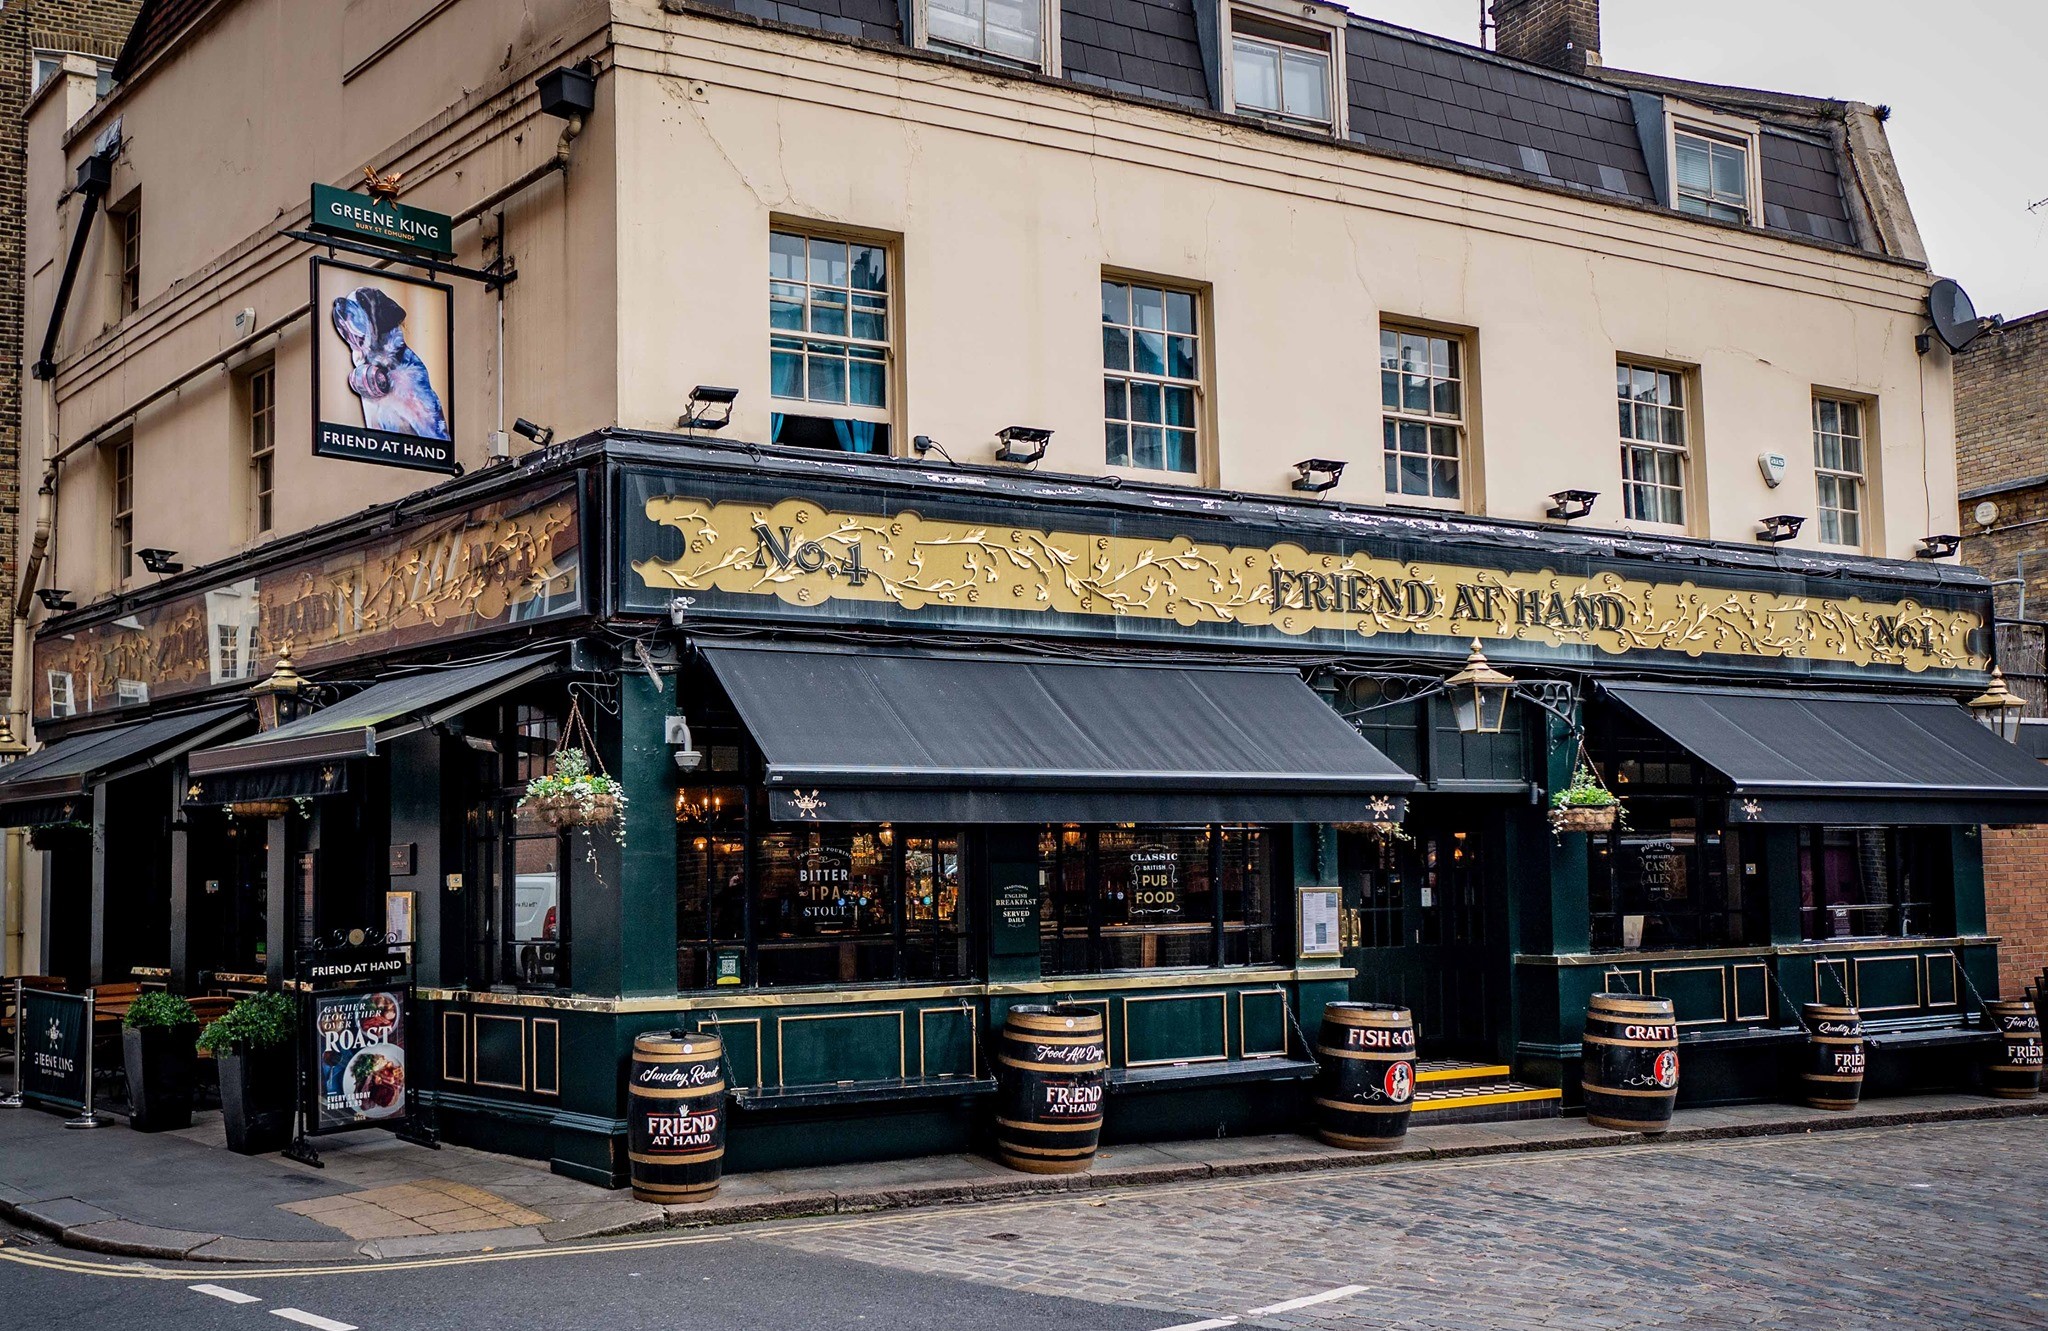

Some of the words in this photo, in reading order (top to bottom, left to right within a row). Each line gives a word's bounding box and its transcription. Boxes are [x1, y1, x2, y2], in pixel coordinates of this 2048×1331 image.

[331, 202, 394, 228] GREENE
[400, 218, 438, 239] KING
[355, 222, 373, 231] BURY
[384, 228, 415, 241] EDMUNDS
[323, 431, 378, 450] FRIEND
[381, 440, 400, 454] AT
[404, 443, 446, 460] HAND
[751, 523, 868, 587] No.4
[1269, 566, 1437, 617] FRIEND
[1450, 581, 1502, 622] AT
[1515, 588, 1627, 631] HAND
[1874, 614, 1934, 656] No.4
[826, 847, 853, 859] POURING
[1130, 852, 1178, 862] CLASSIC
[1645, 861, 1672, 872] CASK
[800, 869, 848, 882] BITTER
[1142, 874, 1168, 887] PUB
[1646, 873, 1671, 884] ALES
[812, 885, 841, 901] IPA
[1136, 891, 1175, 904] FOOD
[995, 898, 1038, 906] BREAKFAST
[804, 906, 847, 917] STOUT
[1002, 910, 1030, 918] SERVED
[312, 964, 352, 977] FRIEND
[354, 963, 368, 973] AT
[370, 960, 402, 971] HAND
[324, 1003, 366, 1014] GATHER
[323, 1010, 382, 1021] TOGETHER
[324, 1020, 352, 1030] OVER
[1818, 1021, 1850, 1036] Quality
[2004, 1016, 2027, 1029] Fine
[325, 1025, 393, 1053] ROAST
[1348, 1028, 1391, 1047] FISH
[1392, 1032, 1402, 1045] &
[1625, 1025, 1671, 1040] CRAFT
[1037, 1045, 1066, 1061] Food
[1065, 1046, 1086, 1062] All
[640, 1065, 689, 1087] Sunday
[690, 1064, 720, 1085] Roast
[327, 1094, 346, 1103] EVERY
[347, 1091, 371, 1101] SUNDAY
[327, 1102, 345, 1111] FROM
[1049, 1104, 1067, 1113] AT
[1069, 1102, 1097, 1113] HAND
[648, 1114, 718, 1138] FRIEND
[652, 1136, 670, 1146] AT
[673, 1133, 711, 1146] HAND
